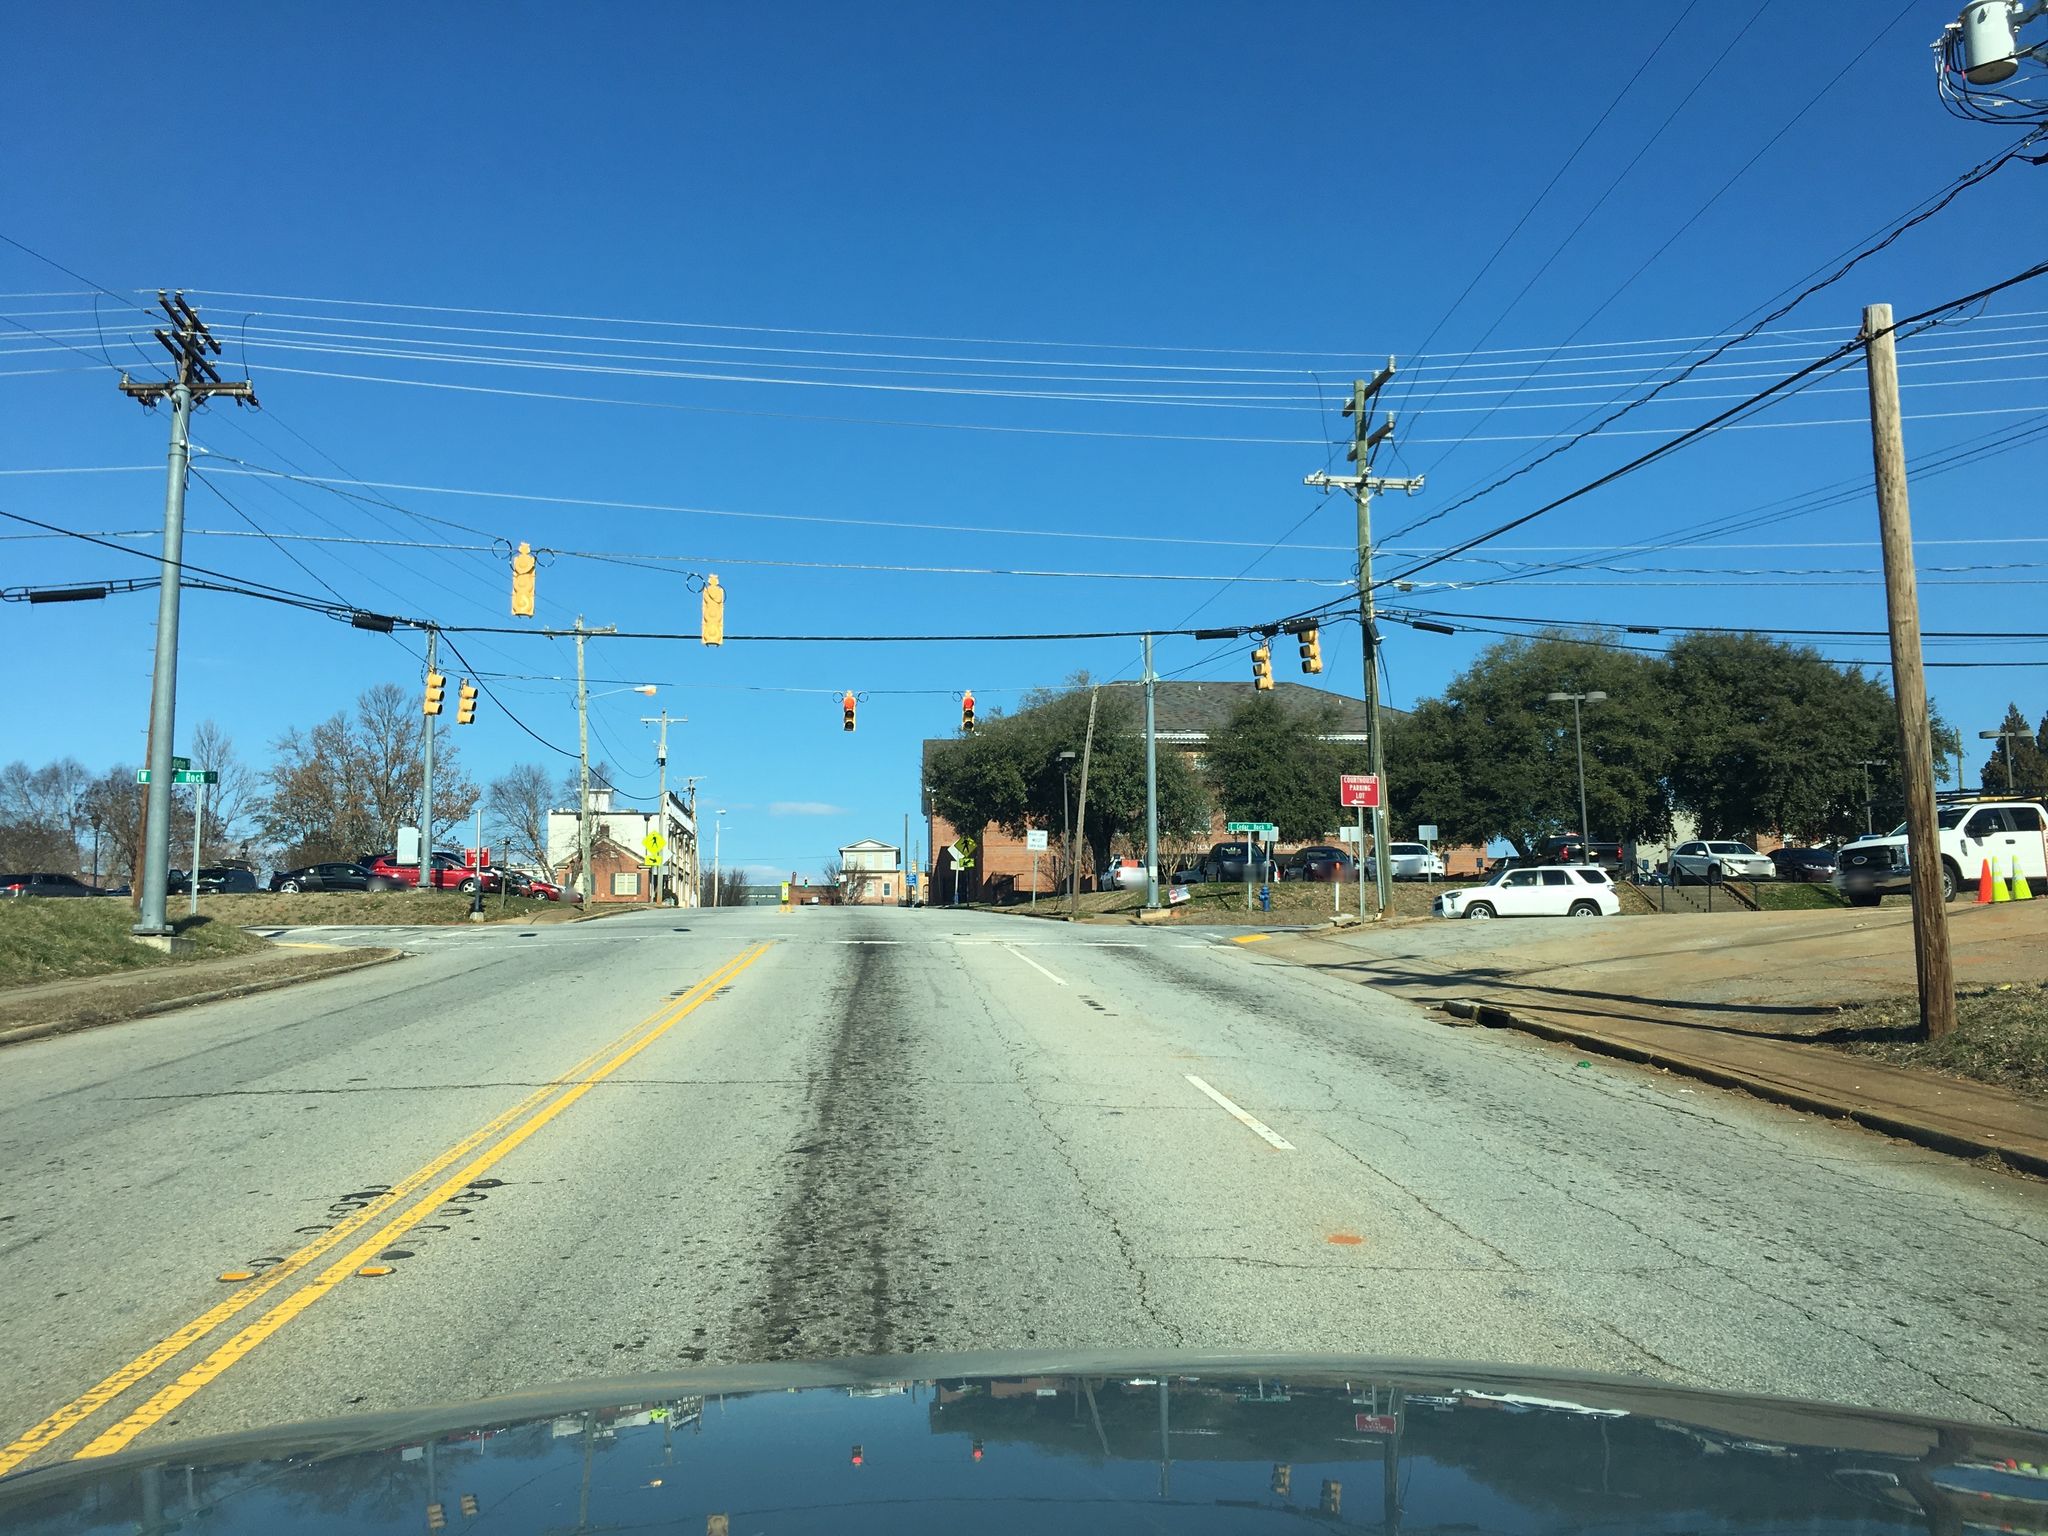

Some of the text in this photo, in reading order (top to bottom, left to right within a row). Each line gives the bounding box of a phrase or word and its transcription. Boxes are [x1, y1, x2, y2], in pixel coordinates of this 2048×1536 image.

[140, 771, 148, 782] W
[185, 772, 205, 783] Rock
[1343, 776, 1376, 784] COURTHOUSE
